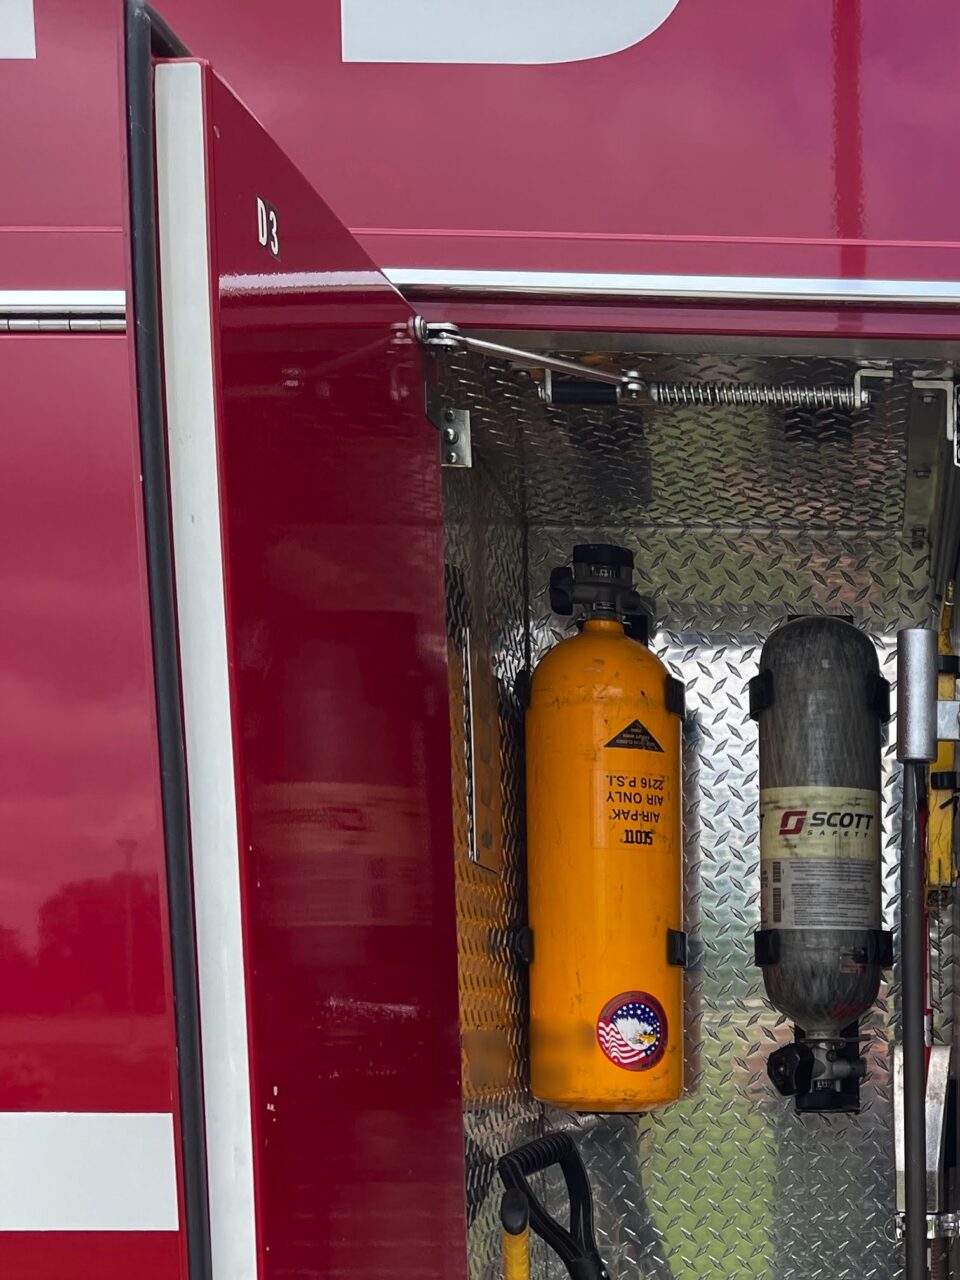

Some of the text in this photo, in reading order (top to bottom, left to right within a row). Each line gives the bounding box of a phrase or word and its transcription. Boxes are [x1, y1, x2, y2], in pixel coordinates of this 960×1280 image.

[257, 197, 279, 255] D3
[605, 775, 664, 791] 2216 P.S.I.
[606, 791, 664, 806] AIR ONLY
[612, 809, 660, 823] AIR-PAK
[809, 811, 874, 830] SCOTT
[623, 830, 653, 845] SCOTT
[807, 829, 869, 838] SAFETY
